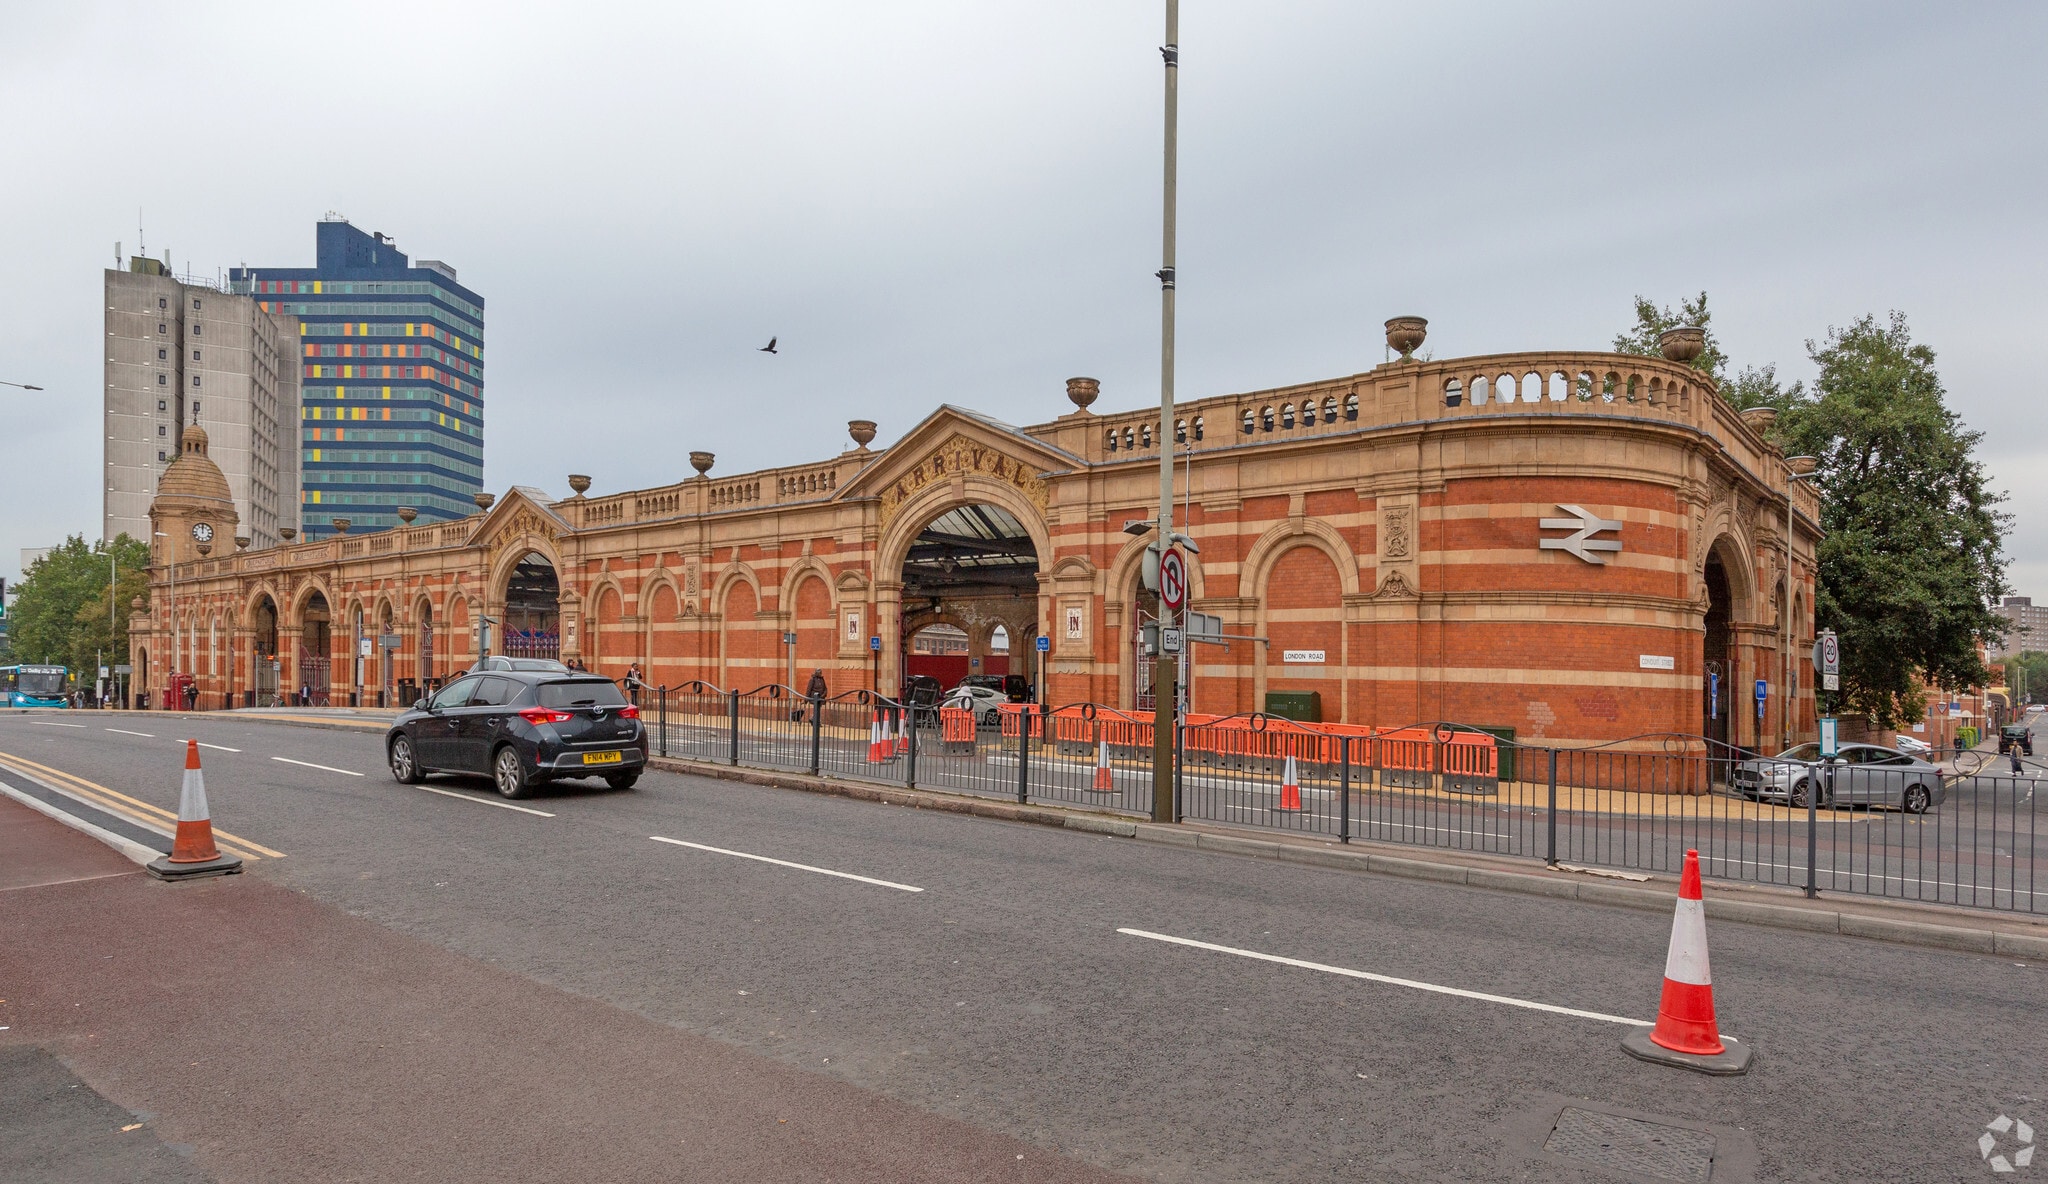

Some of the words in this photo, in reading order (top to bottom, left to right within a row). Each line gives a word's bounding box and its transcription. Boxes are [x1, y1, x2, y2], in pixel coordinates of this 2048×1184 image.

[896, 448, 1026, 505] ARRIVAL
[496, 515, 554, 551] ARRIVAL
[1166, 634, 1178, 645] End
[1826, 644, 1835, 656] 20
[1825, 664, 1837, 672] ZONE
[1757, 684, 1765, 695] IN
[587, 753, 603, 762] FN14
[604, 752, 618, 761] WPY
